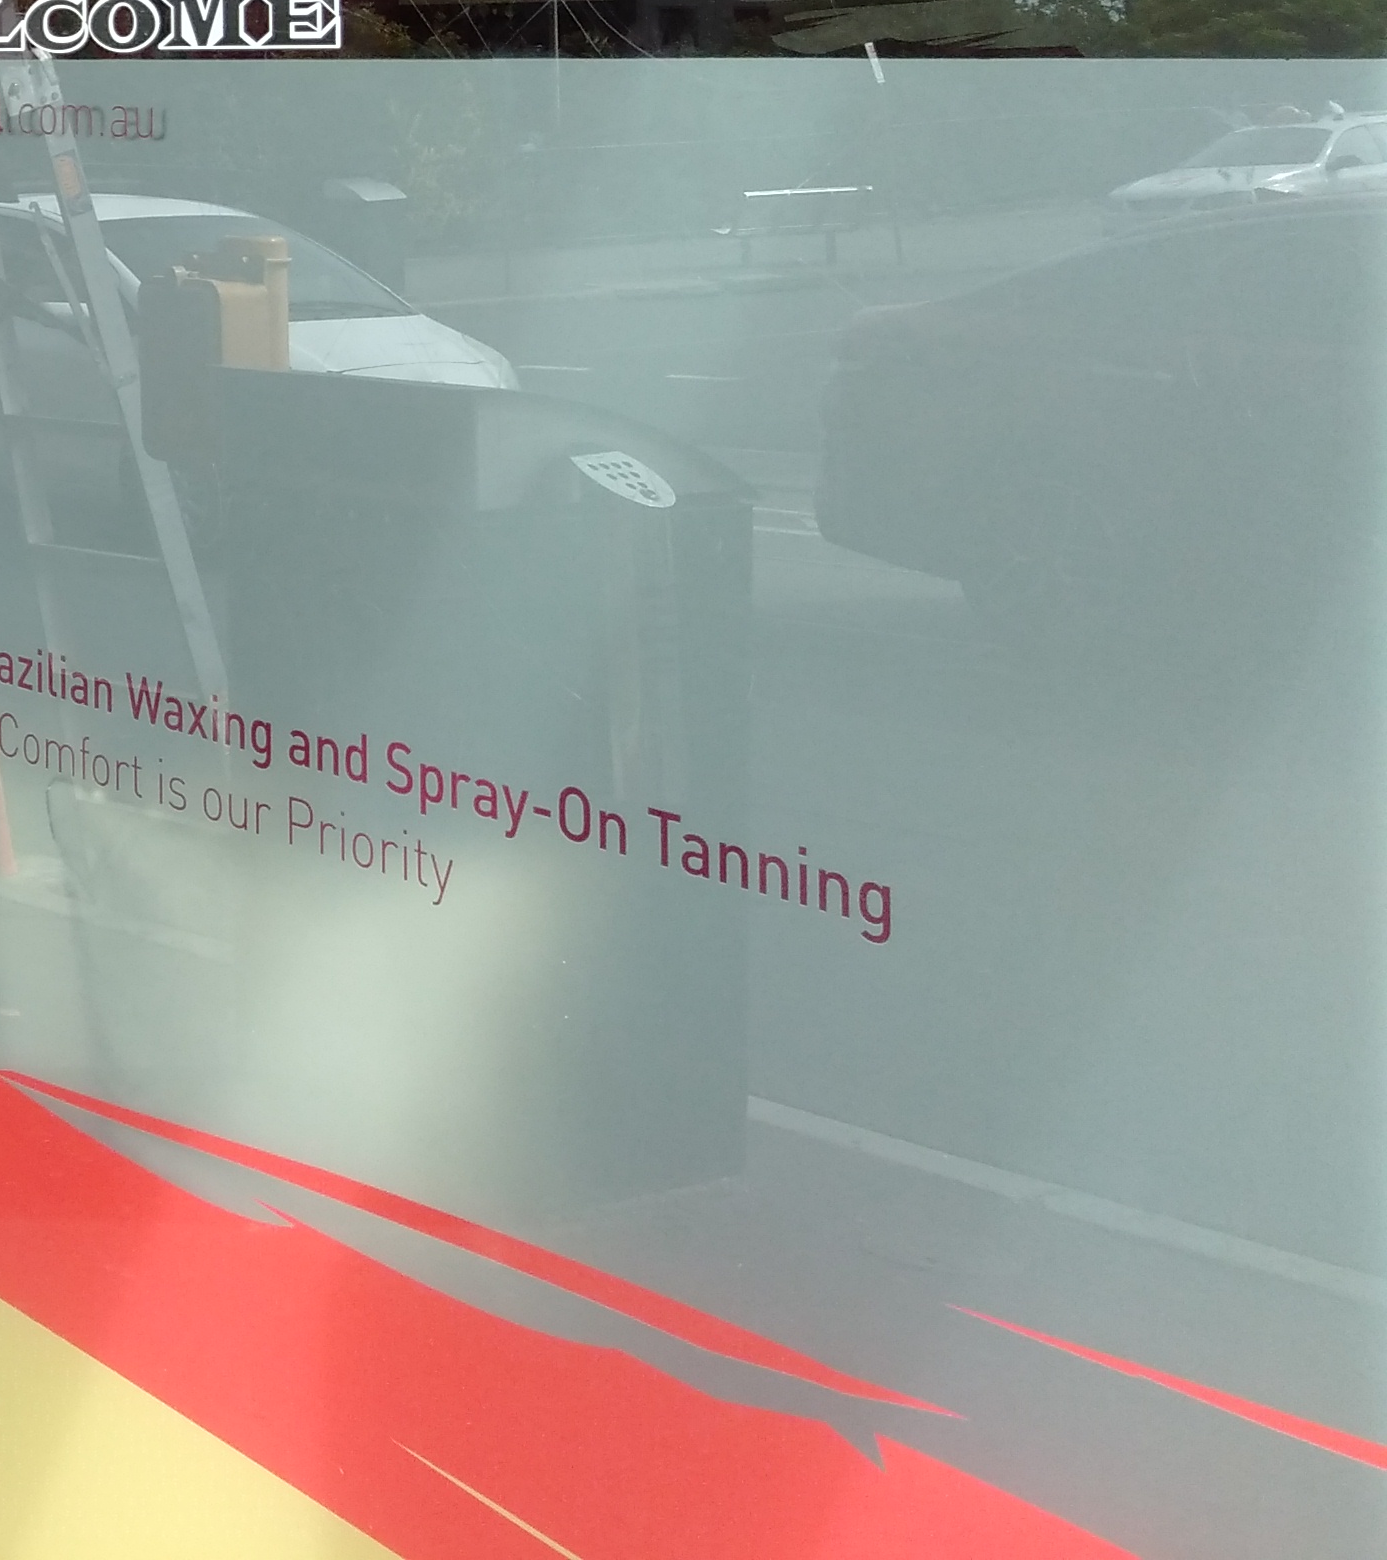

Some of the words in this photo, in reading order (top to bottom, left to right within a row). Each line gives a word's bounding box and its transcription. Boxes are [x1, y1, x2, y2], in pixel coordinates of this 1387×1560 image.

[125, 672, 273, 770] Waxing
[288, 729, 369, 784] and
[385, 741, 628, 856] Spray-On
[647, 806, 893, 945] Tanning
[157, 759, 188, 812] is
[202, 786, 272, 835] our
[288, 796, 454, 906] Priority
